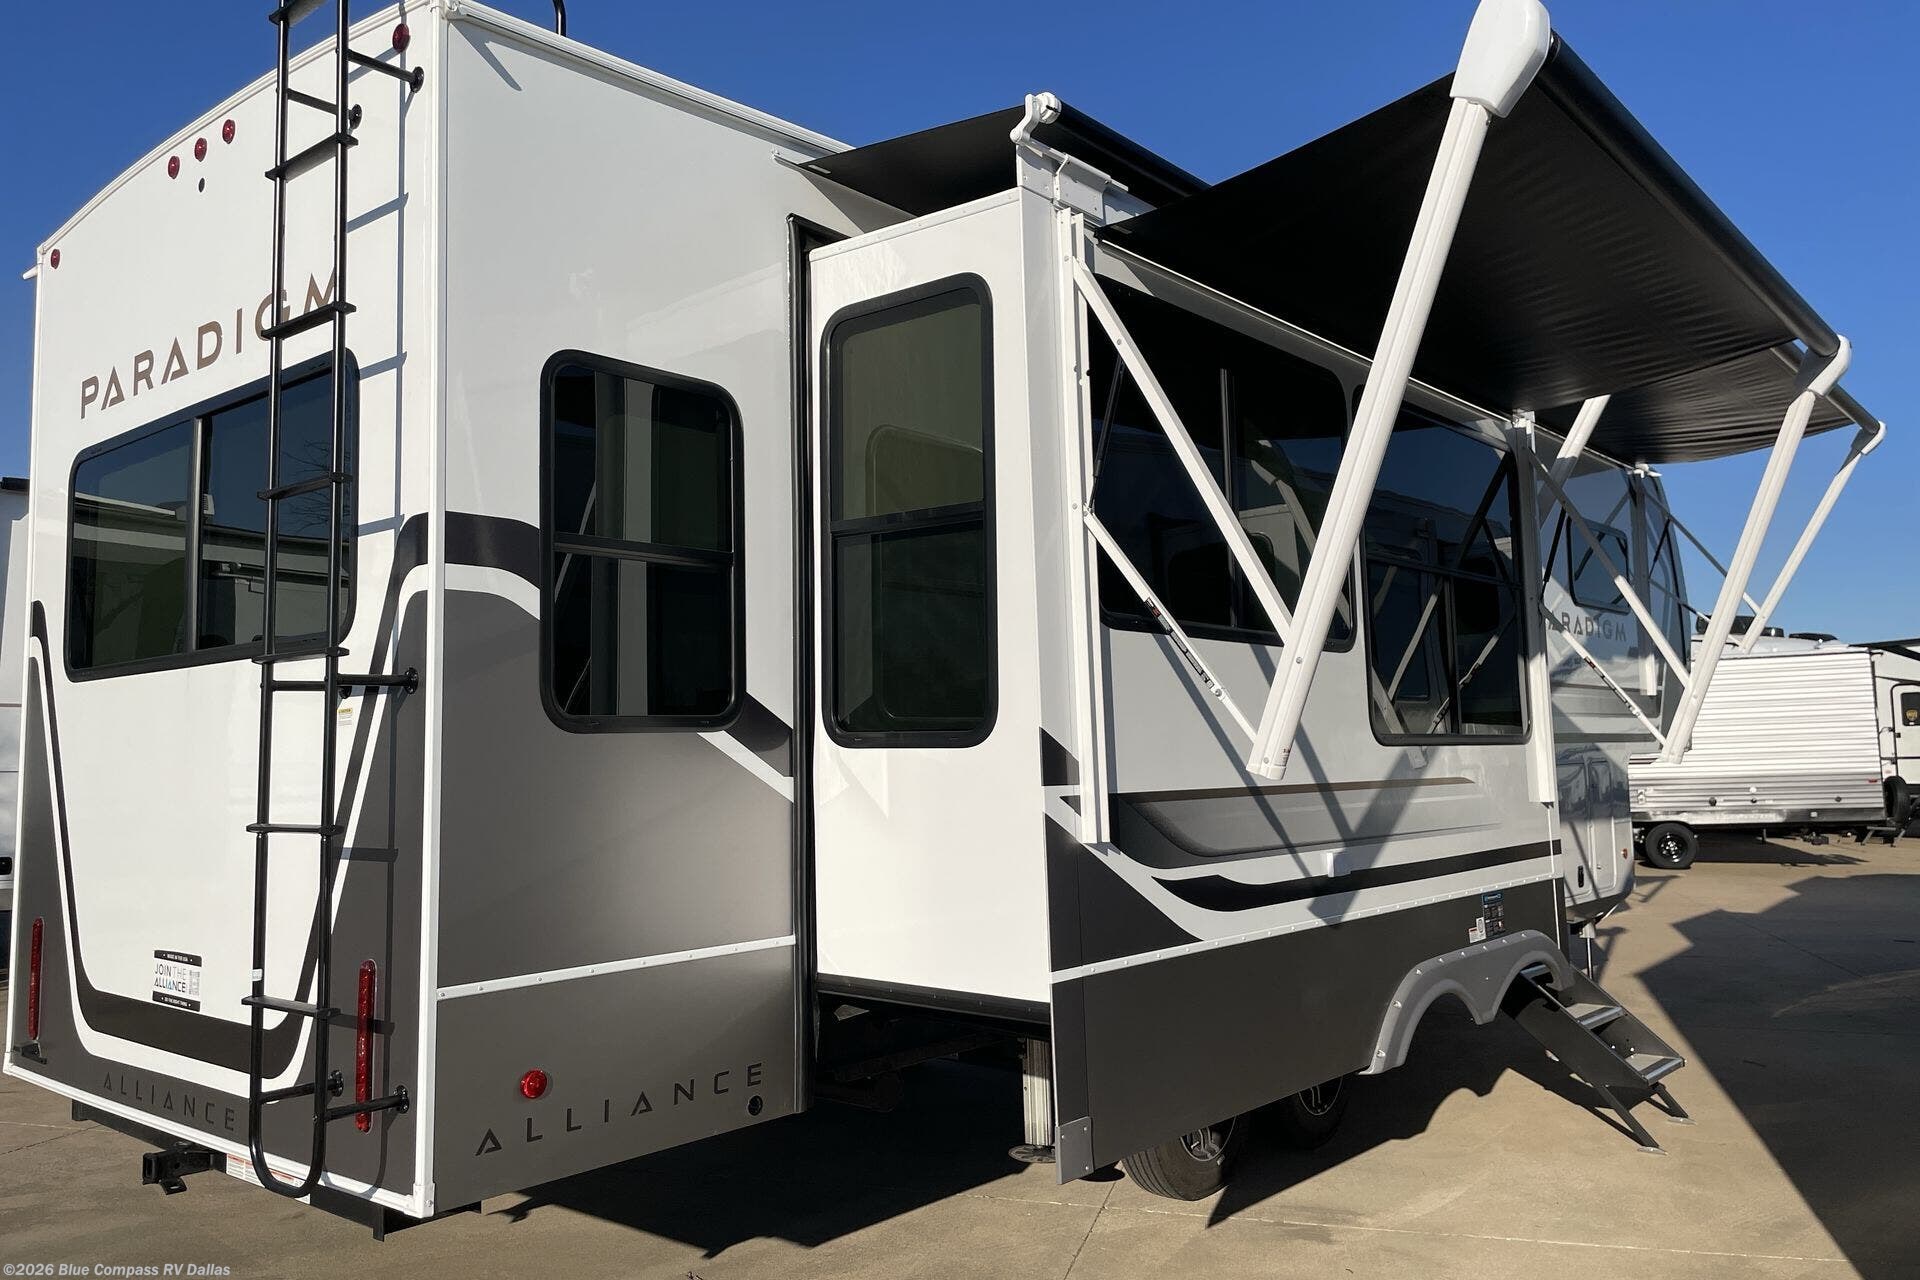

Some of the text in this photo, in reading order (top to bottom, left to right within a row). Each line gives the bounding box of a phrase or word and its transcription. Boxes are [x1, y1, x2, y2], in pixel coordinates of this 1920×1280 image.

[154, 977, 186, 993] ALLIANCE
[155, 963, 187, 981] JOIN THE
[103, 1071, 235, 1132] ALLIANCE
[475, 1062, 762, 1157] ALLIANCE
